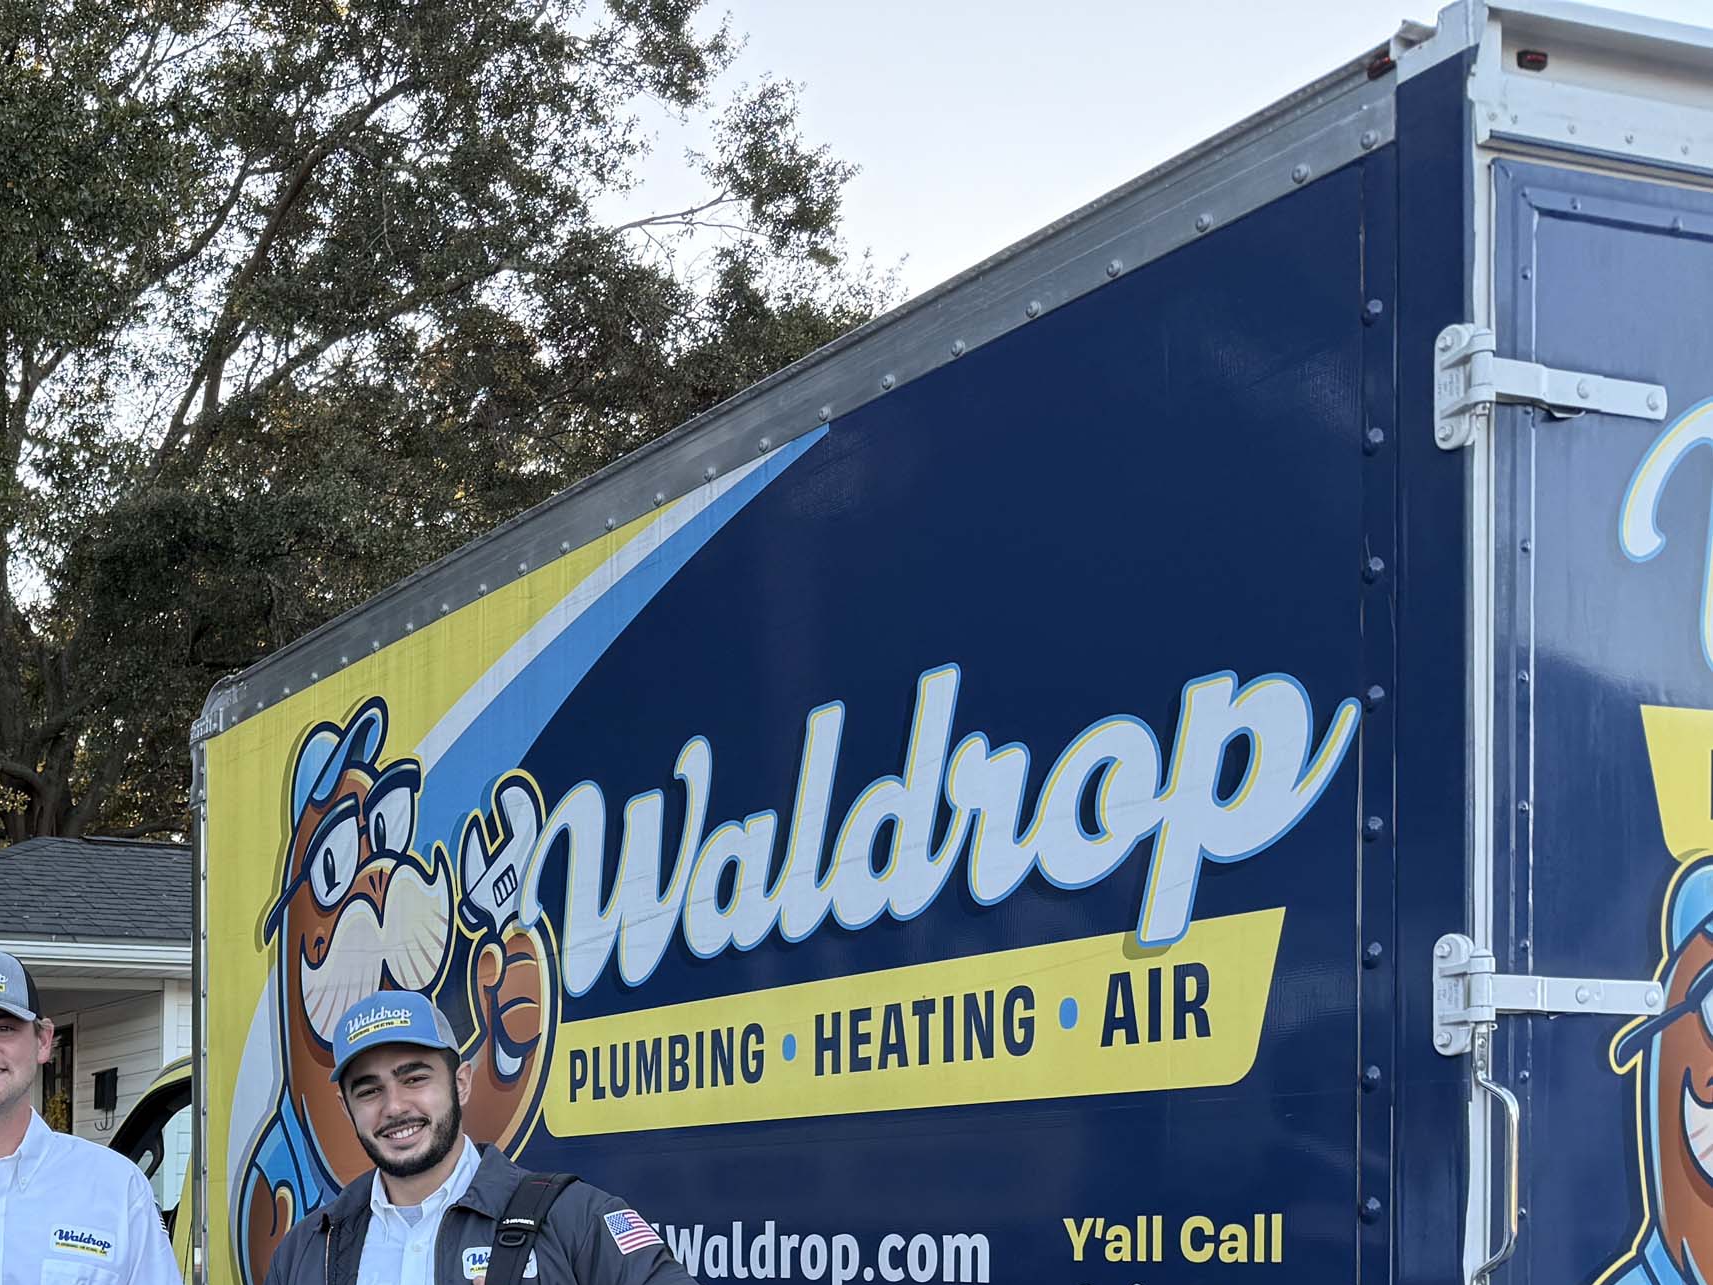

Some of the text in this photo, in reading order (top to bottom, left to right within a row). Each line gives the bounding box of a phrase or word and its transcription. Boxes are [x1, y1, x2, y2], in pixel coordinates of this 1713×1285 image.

[519, 662, 1363, 998] Waldrop
[345, 1007, 413, 1034] Waldrop
[568, 961, 1212, 1103] PLUMBING HEATING AIR
[54, 1229, 112, 1250] Waldrop
[1063, 1213, 1283, 1265] Y'all Call
